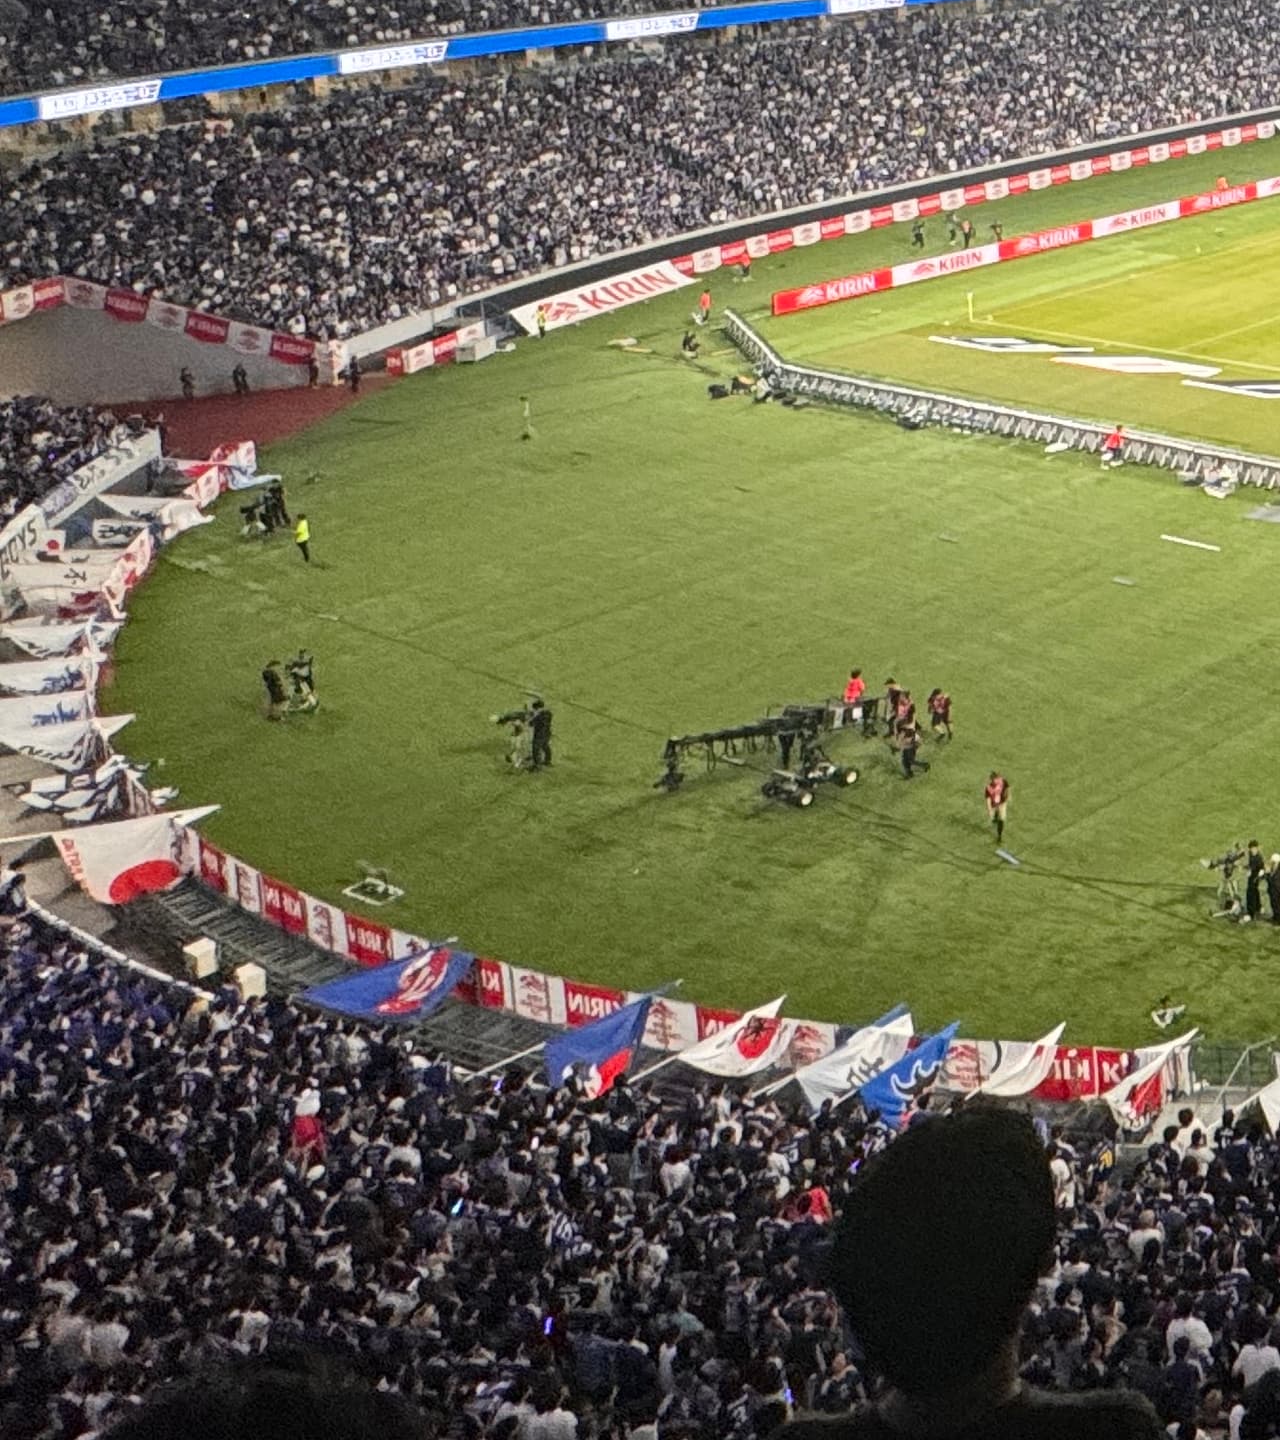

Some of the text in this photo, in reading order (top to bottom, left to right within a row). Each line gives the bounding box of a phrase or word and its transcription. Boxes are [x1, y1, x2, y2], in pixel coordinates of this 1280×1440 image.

[1211, 187, 1247, 207] KIRIN
[1130, 208, 1167, 226] KIRIN
[1038, 227, 1080, 249] KIRIN
[939, 251, 983, 272] KIRIN
[578, 269, 678, 310] KIRIN
[826, 274, 877, 301] KIRIN
